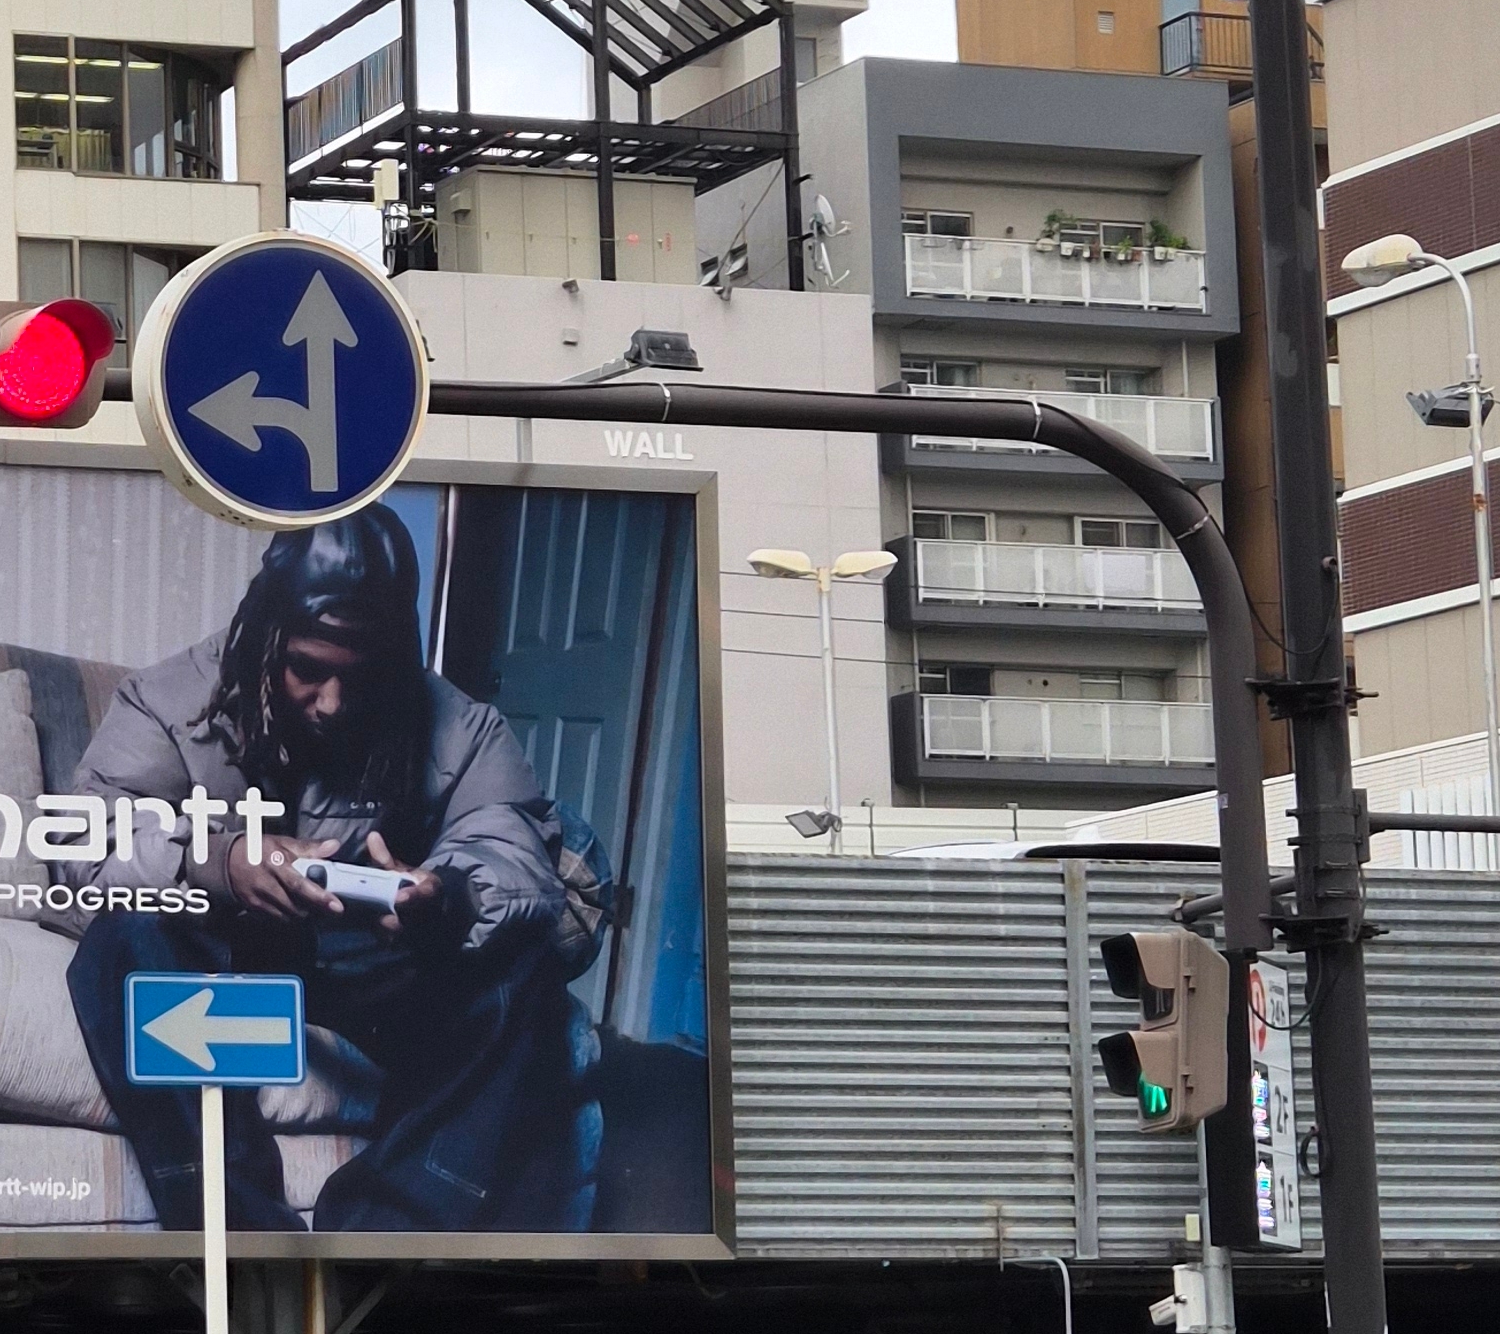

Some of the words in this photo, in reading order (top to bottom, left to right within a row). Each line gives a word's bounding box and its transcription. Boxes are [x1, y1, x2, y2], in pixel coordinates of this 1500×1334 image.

[604, 429, 694, 461] WALL
[1274, 1085, 1288, 1135] 2F
[1280, 1175, 1294, 1224] 1F
